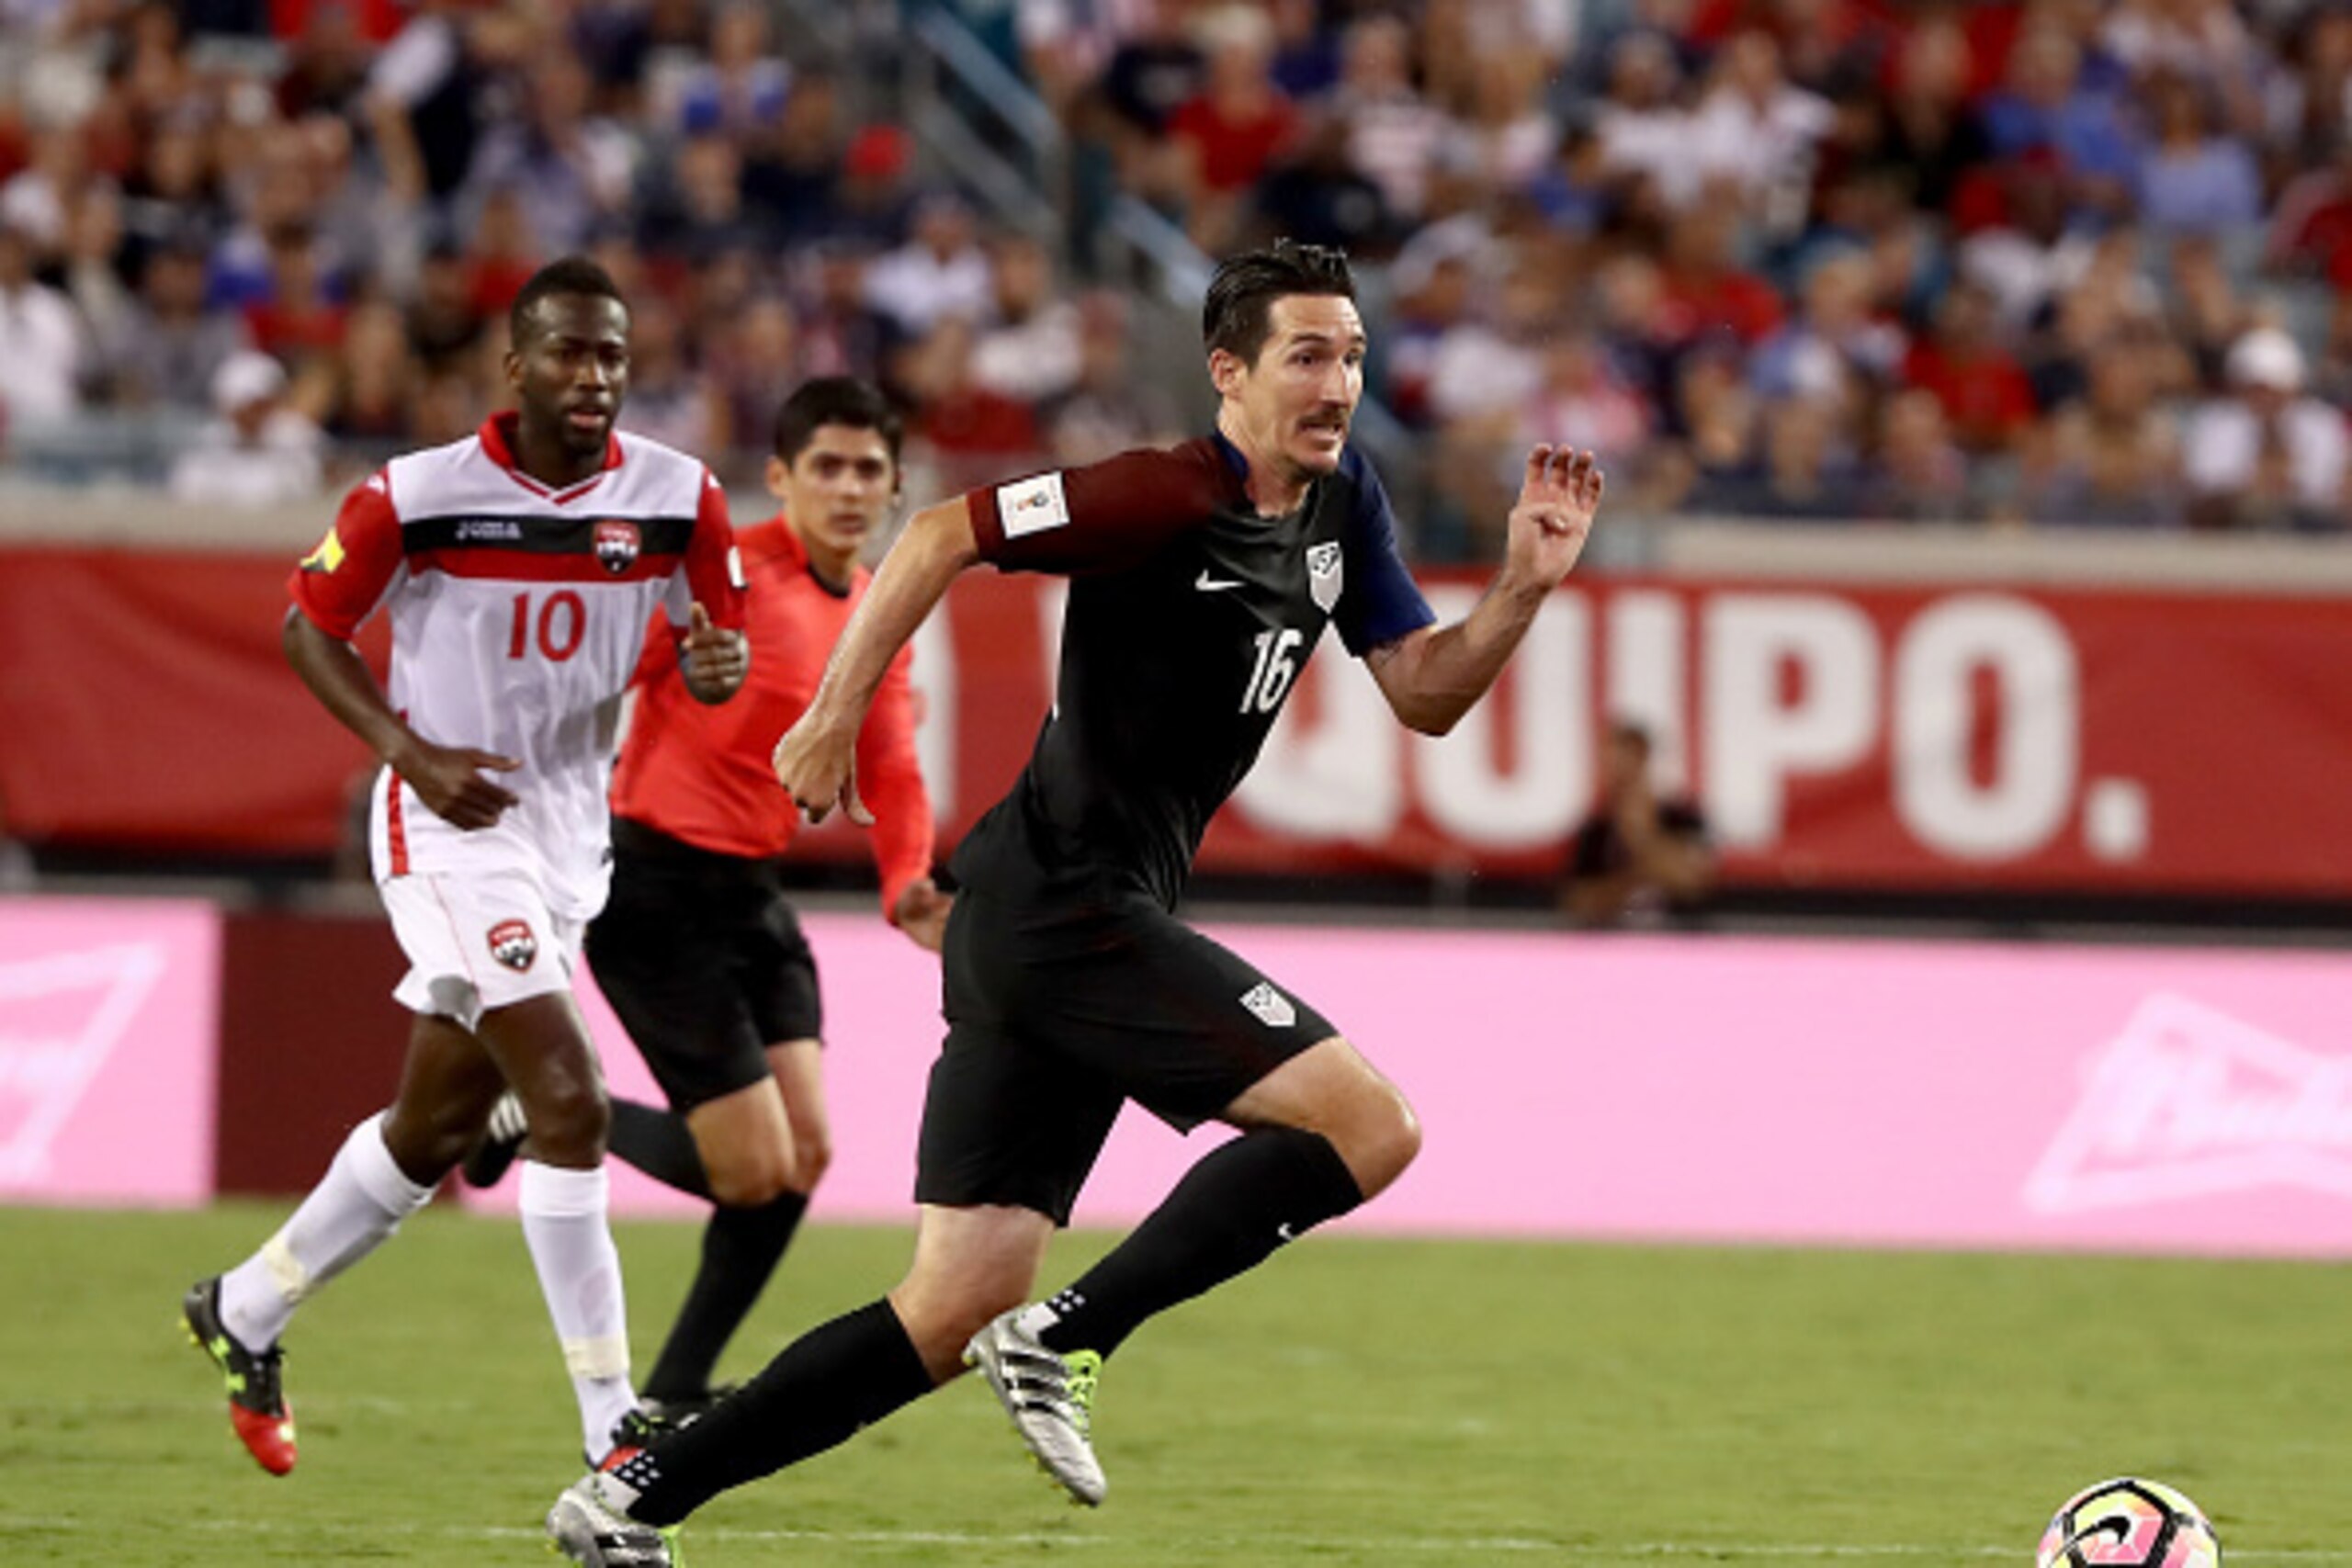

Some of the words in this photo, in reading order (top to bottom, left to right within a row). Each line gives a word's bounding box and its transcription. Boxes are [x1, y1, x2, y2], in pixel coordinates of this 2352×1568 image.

[507, 589, 587, 662] 10
[1238, 628, 1304, 714] 16
[1040, 582, 2150, 865] QUIPO.
